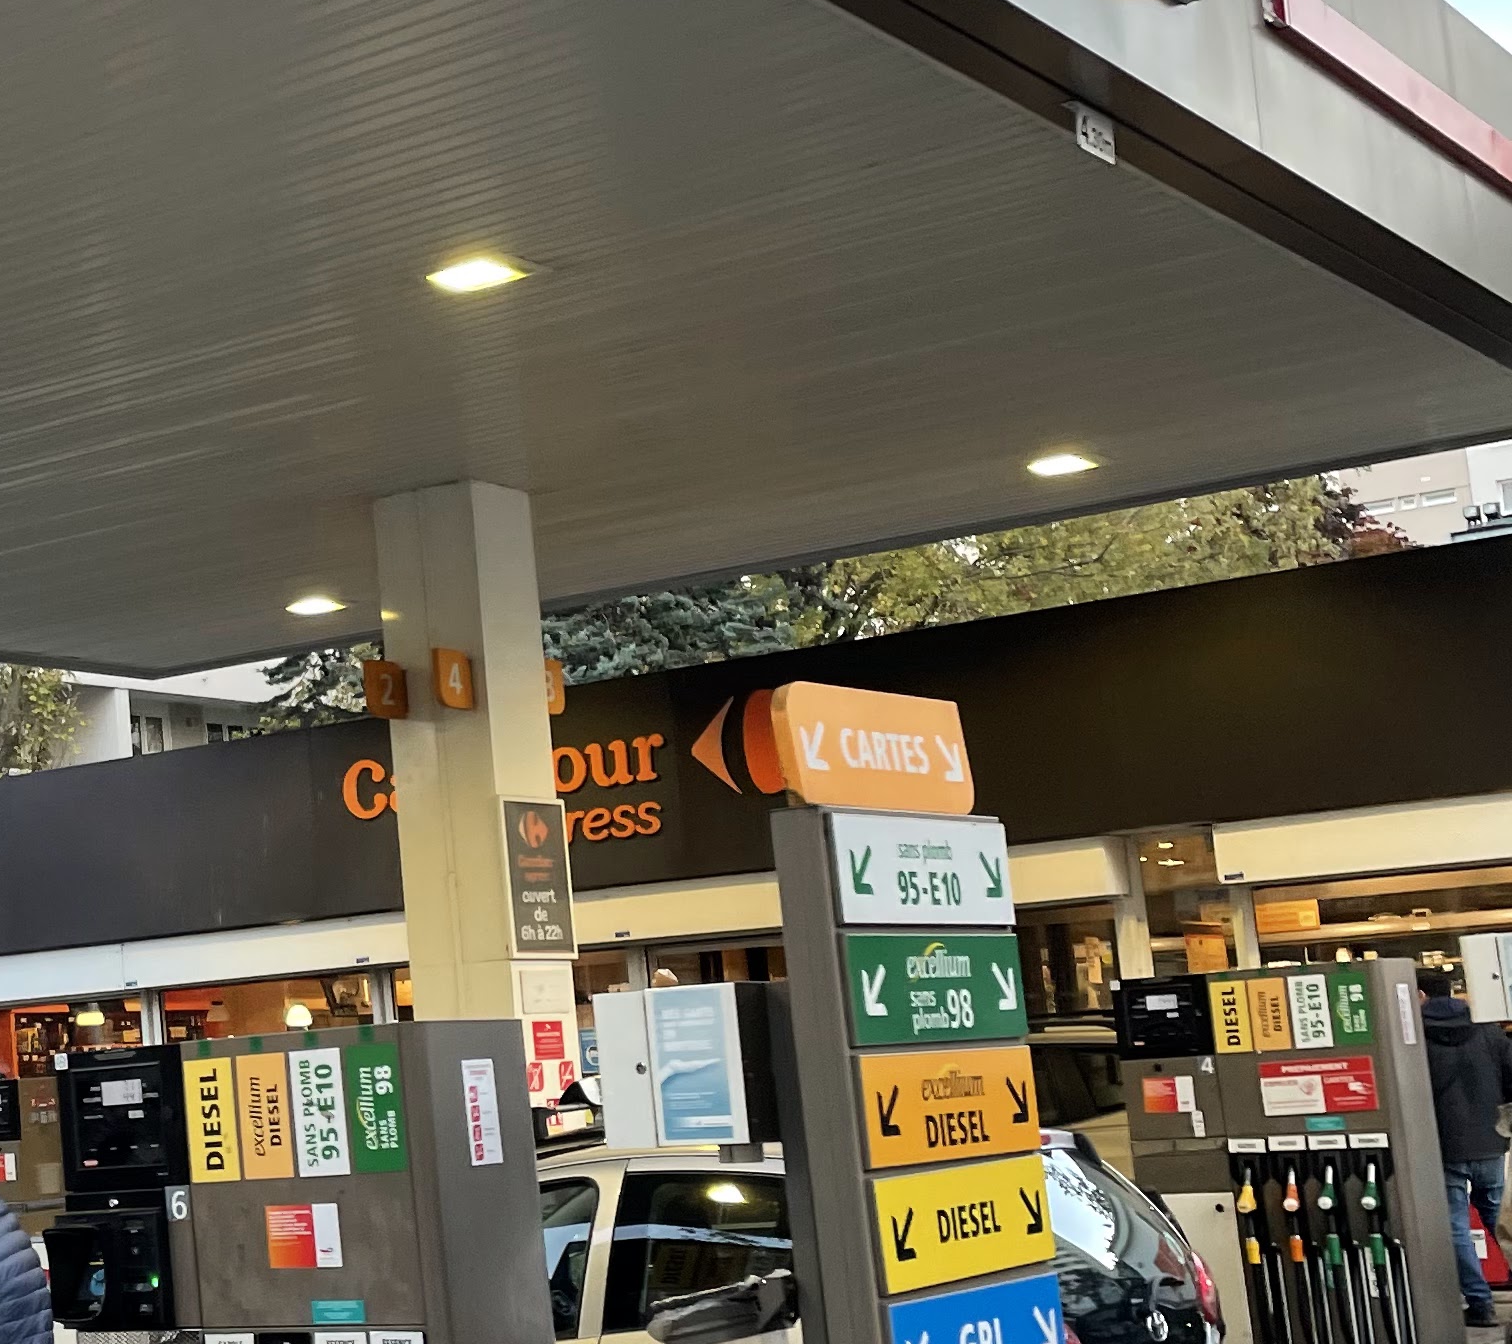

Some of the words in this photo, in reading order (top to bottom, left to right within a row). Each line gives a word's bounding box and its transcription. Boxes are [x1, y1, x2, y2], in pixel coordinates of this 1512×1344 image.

[379, 673, 395, 706] 2
[448, 662, 463, 696] 4
[839, 728, 931, 774] CARTES
[897, 871, 961, 906] 95-E10
[534, 906, 549, 922] de
[946, 988, 975, 1030] 98
[1221, 986, 1241, 1047] DIESEL
[1270, 995, 1283, 1032] DIESEL
[1306, 983, 1326, 1039] 95-E10
[373, 1064, 394, 1096] 98
[1200, 1056, 1215, 1074] 4
[298, 1059, 316, 1117] PLOMB
[358, 1066, 379, 1151] excellium
[199, 1067, 225, 1171] DIESEL
[248, 1076, 267, 1157] excellium
[266, 1083, 283, 1147] DIESEL
[314, 1063, 341, 1161] 95-E10
[387, 1110, 399, 1149] PLOMB
[924, 1109, 991, 1148] DIESEL
[304, 1123, 320, 1168] SANS
[379, 1119, 390, 1150] SANS
[171, 1190, 188, 1221] 6
[936, 1199, 1002, 1244] DIESEL
